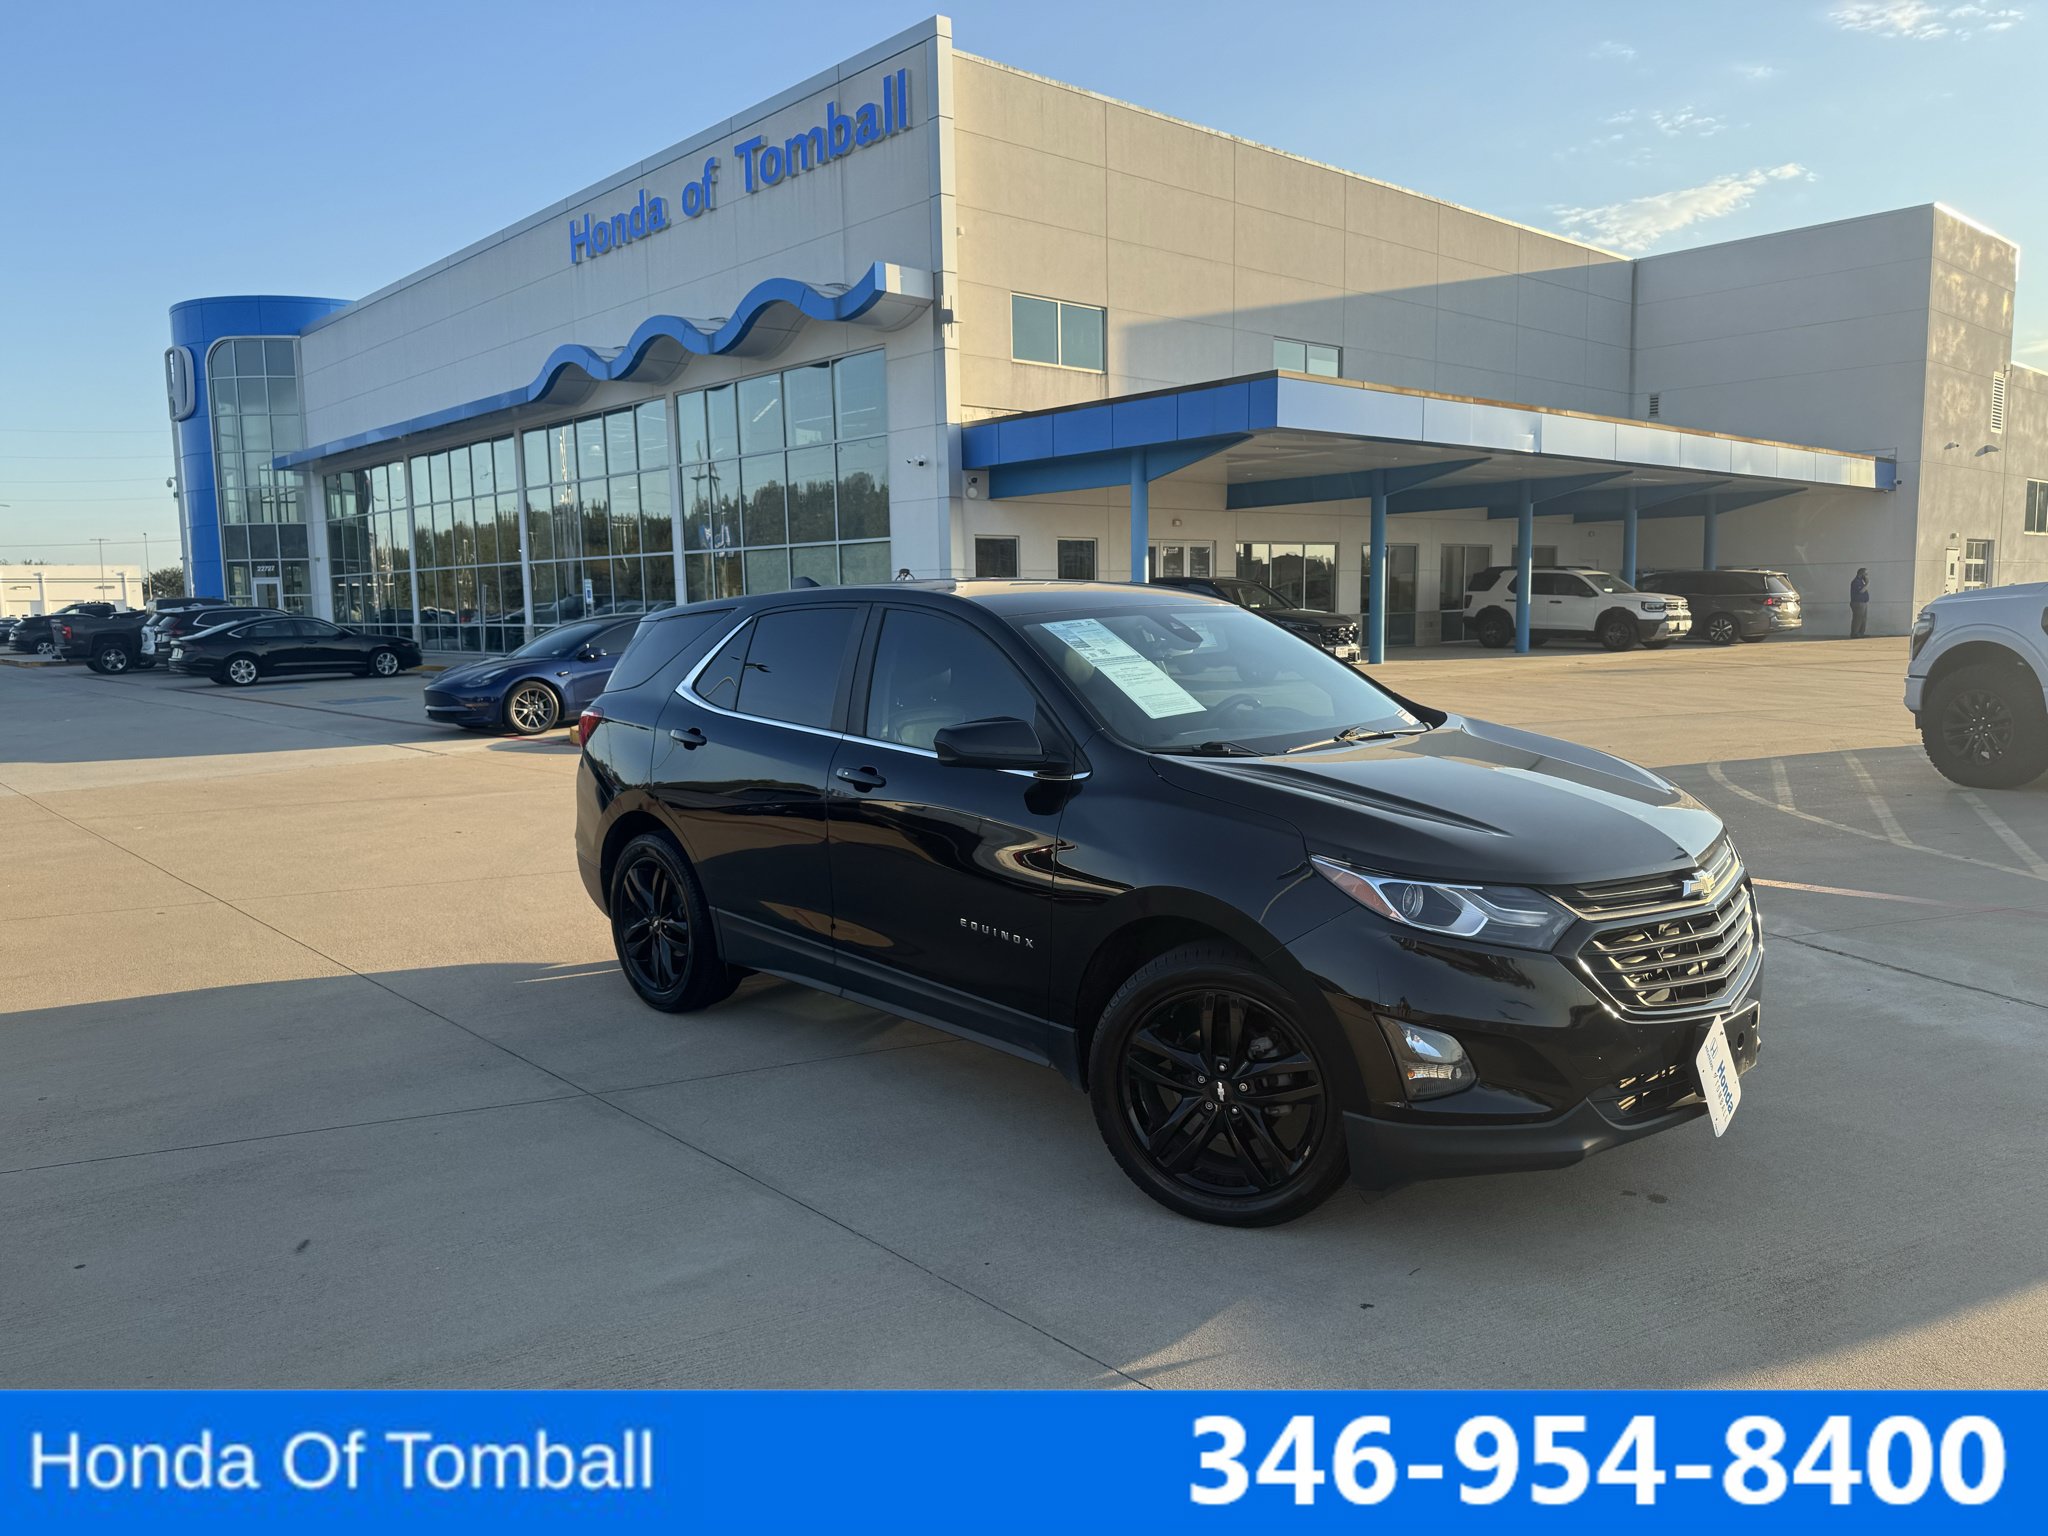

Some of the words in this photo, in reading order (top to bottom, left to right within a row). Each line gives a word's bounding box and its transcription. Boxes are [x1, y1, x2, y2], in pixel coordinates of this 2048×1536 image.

[569, 188, 671, 264] Honda
[681, 156, 720, 218] of
[734, 67, 912, 194] Tomball
[960, 918, 1034, 949] EQUINOX
[1714, 1080, 1728, 1122] TOMBALL
[1717, 1060, 1734, 1115] Honda
